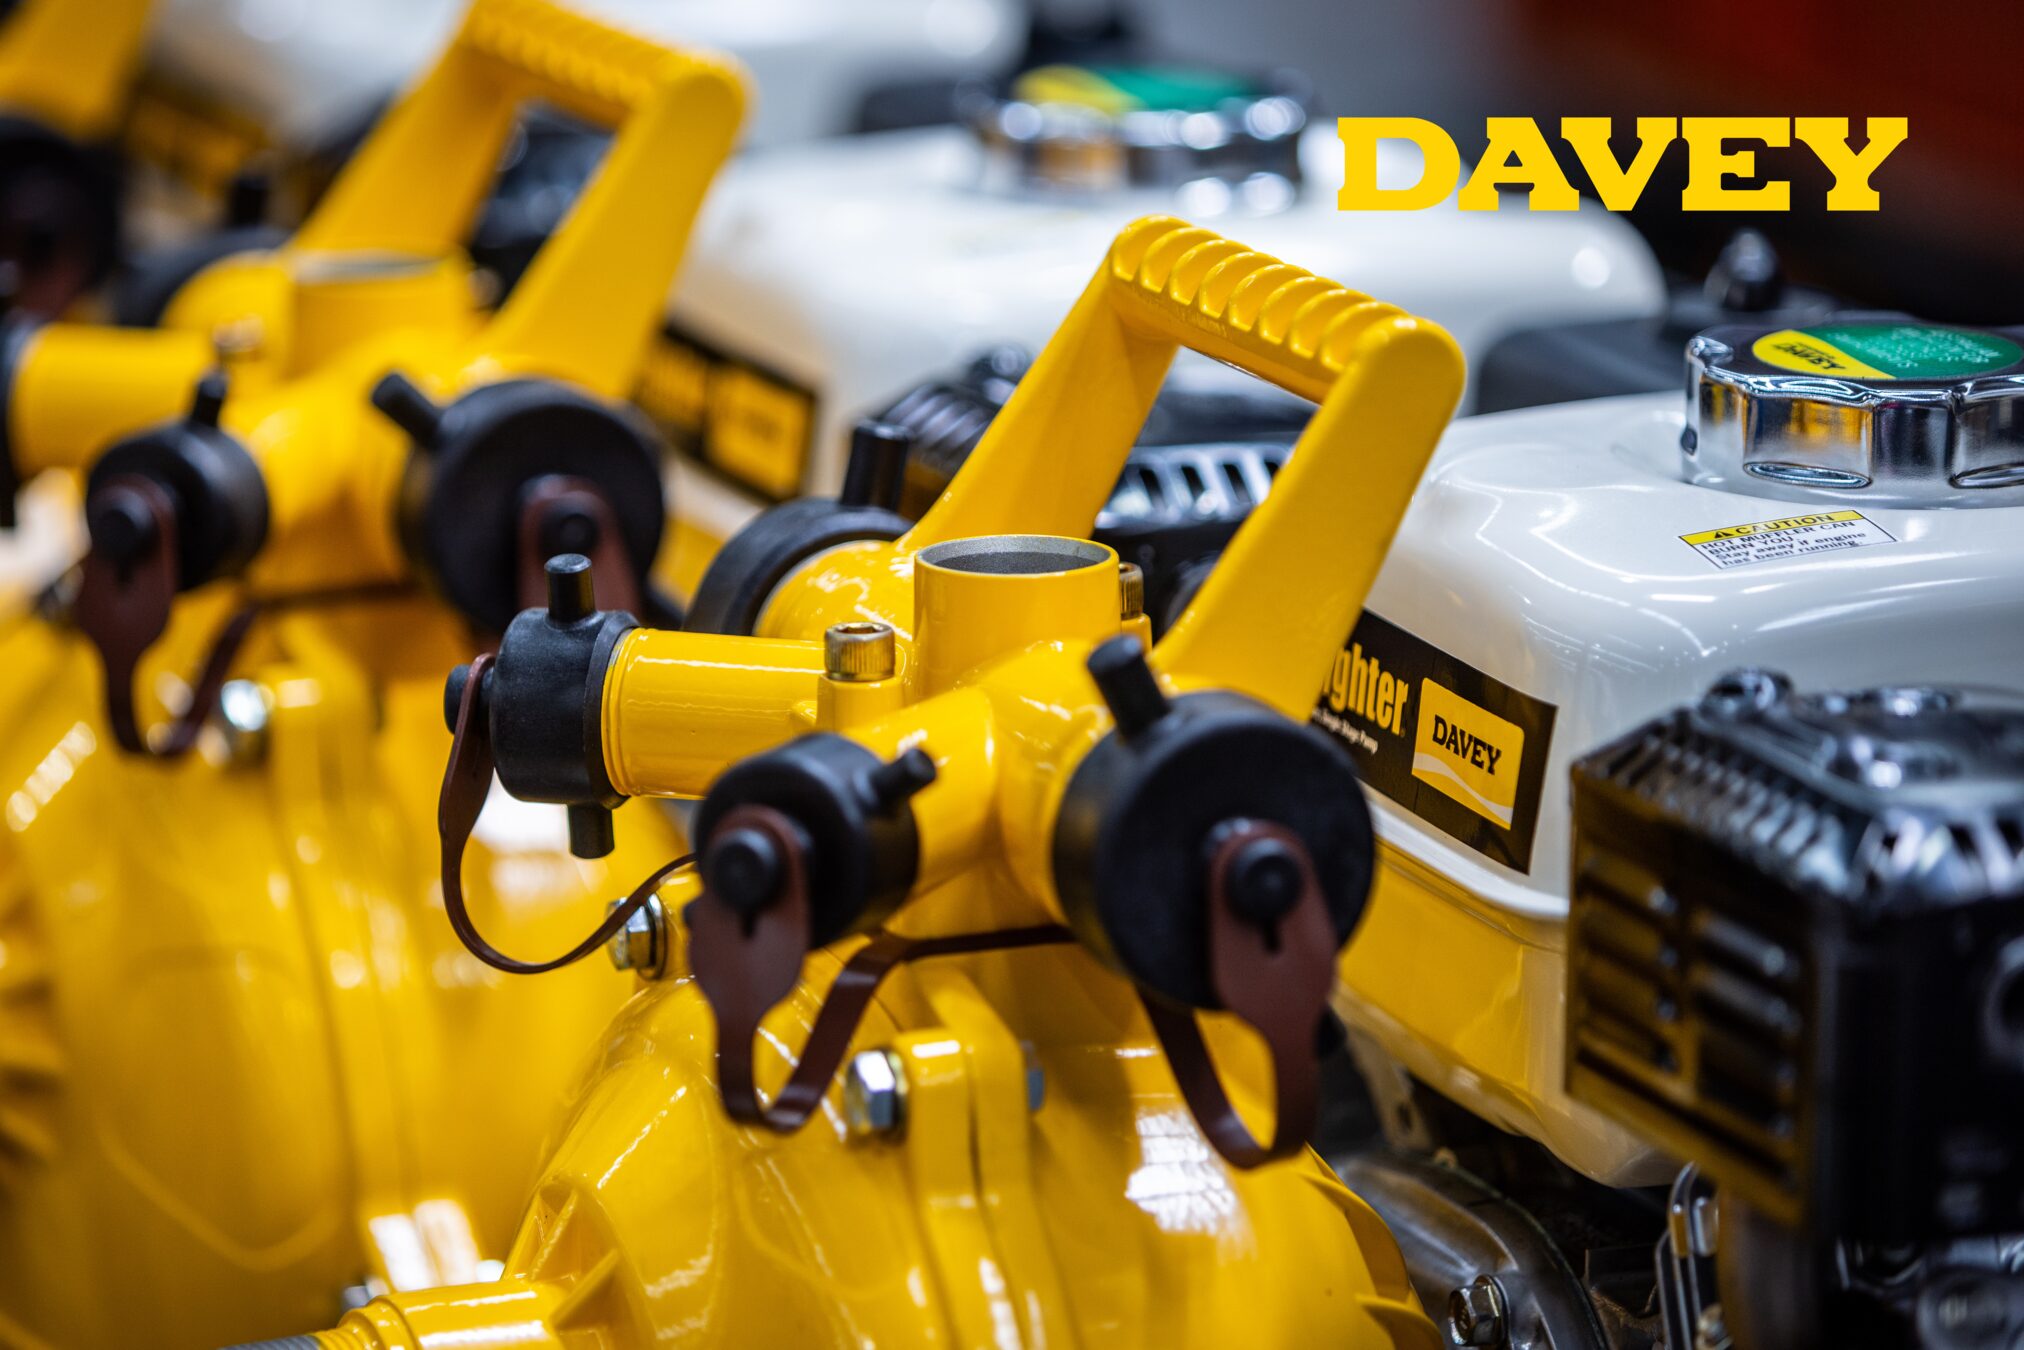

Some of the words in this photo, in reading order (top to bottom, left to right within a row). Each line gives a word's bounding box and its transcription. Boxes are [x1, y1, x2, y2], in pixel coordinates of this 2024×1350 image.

[1701, 540, 1734, 550] HOT
[1739, 526, 1816, 543] MUFFLER
[1820, 521, 1856, 530] CAN
[1735, 514, 1835, 535] CAUTION
[1708, 542, 1754, 555] BURN
[1716, 550, 1750, 560] Stay
[1756, 543, 1794, 554] away
[1815, 532, 1867, 543] engine
[1432, 714, 1503, 776] DAVEY
